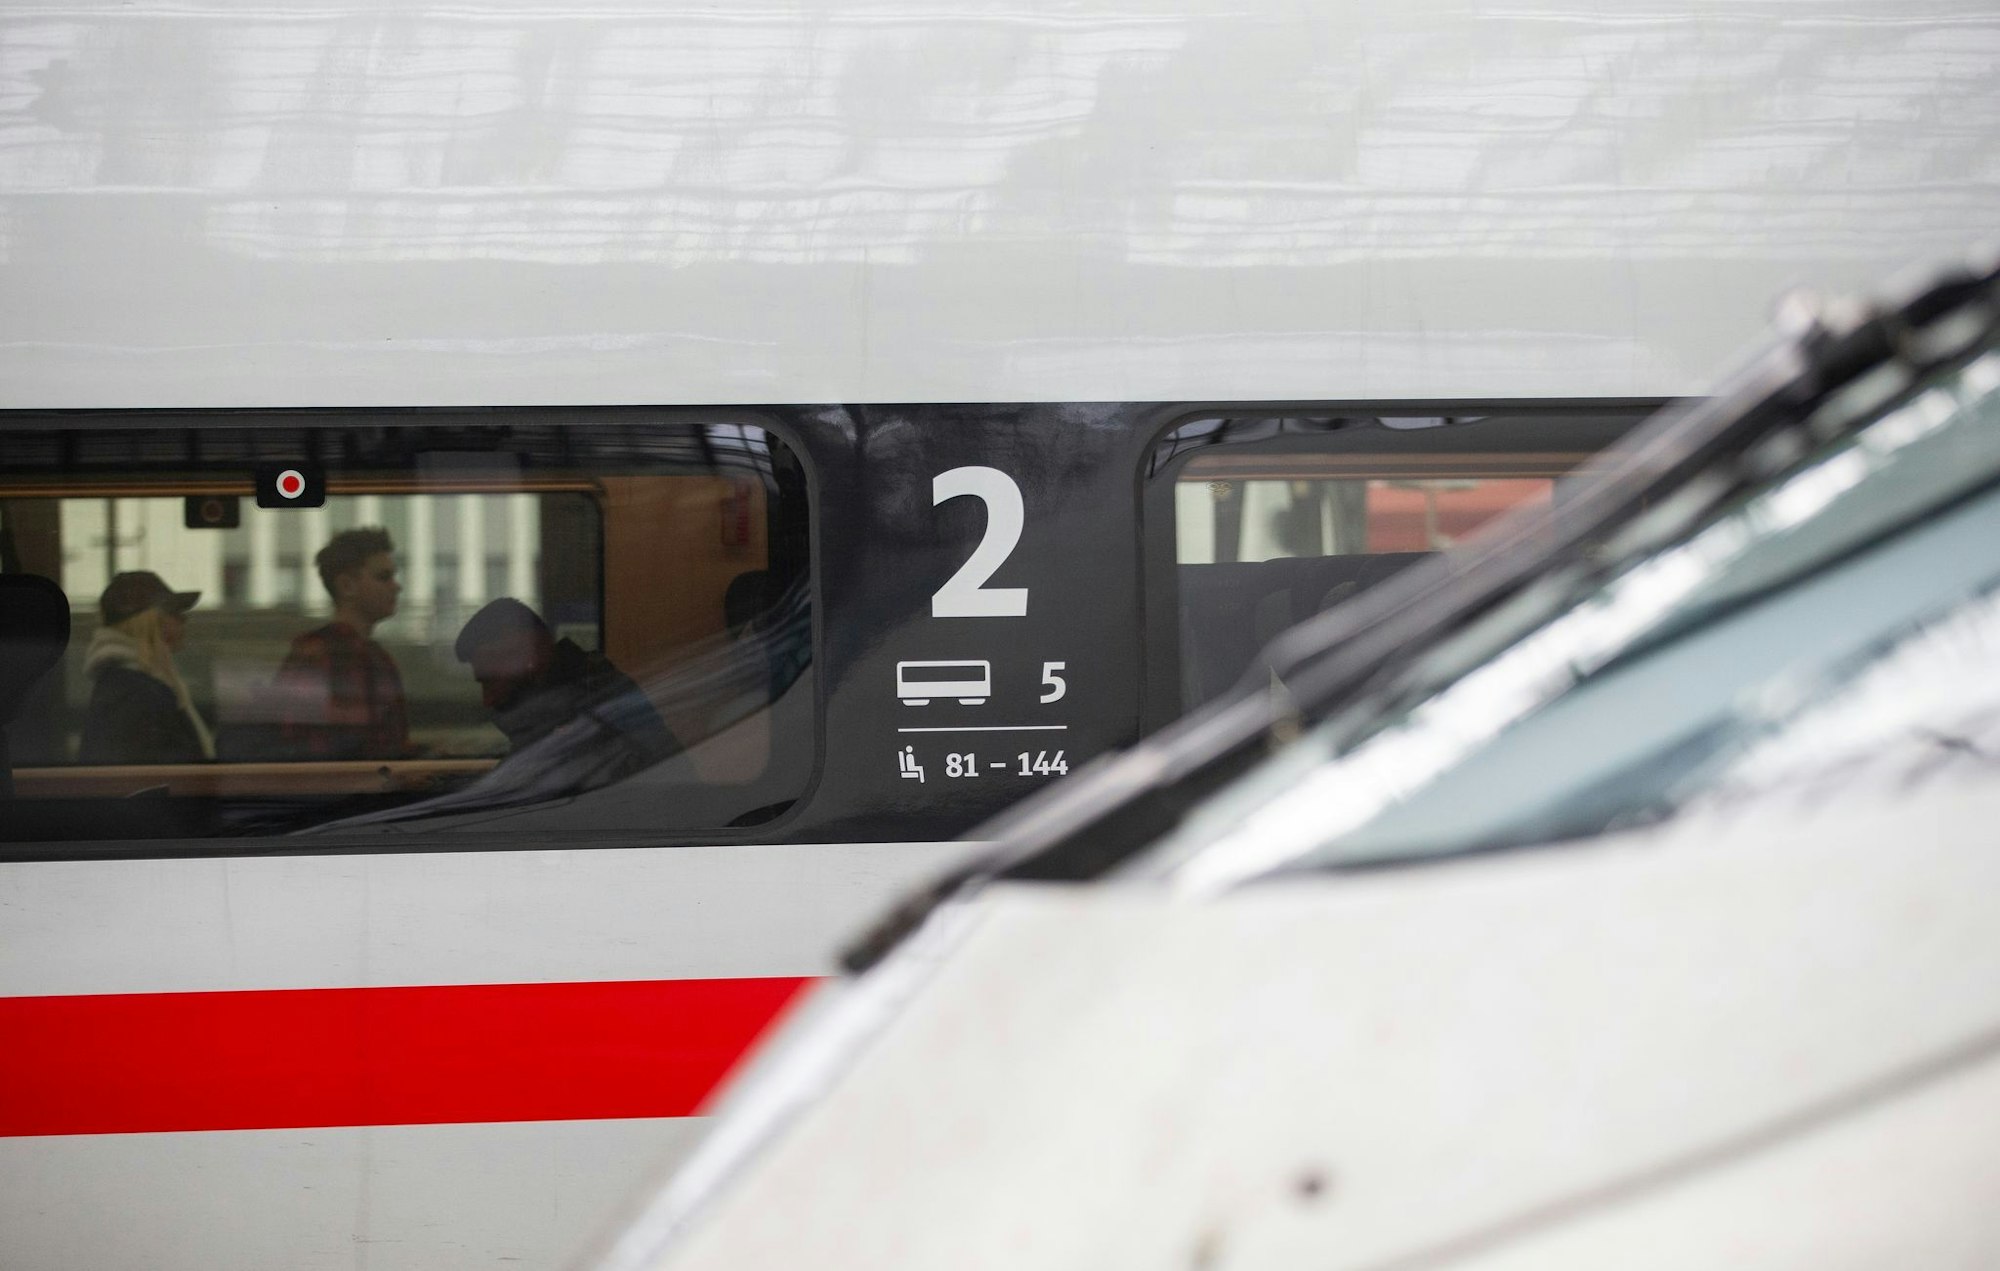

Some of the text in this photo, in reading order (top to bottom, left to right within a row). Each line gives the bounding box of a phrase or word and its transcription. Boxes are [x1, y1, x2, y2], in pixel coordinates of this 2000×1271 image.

[931, 465, 1029, 618] 2
[1039, 661, 1067, 704] 5
[945, 752, 979, 778] 81
[1017, 750, 1069, 776] 144
